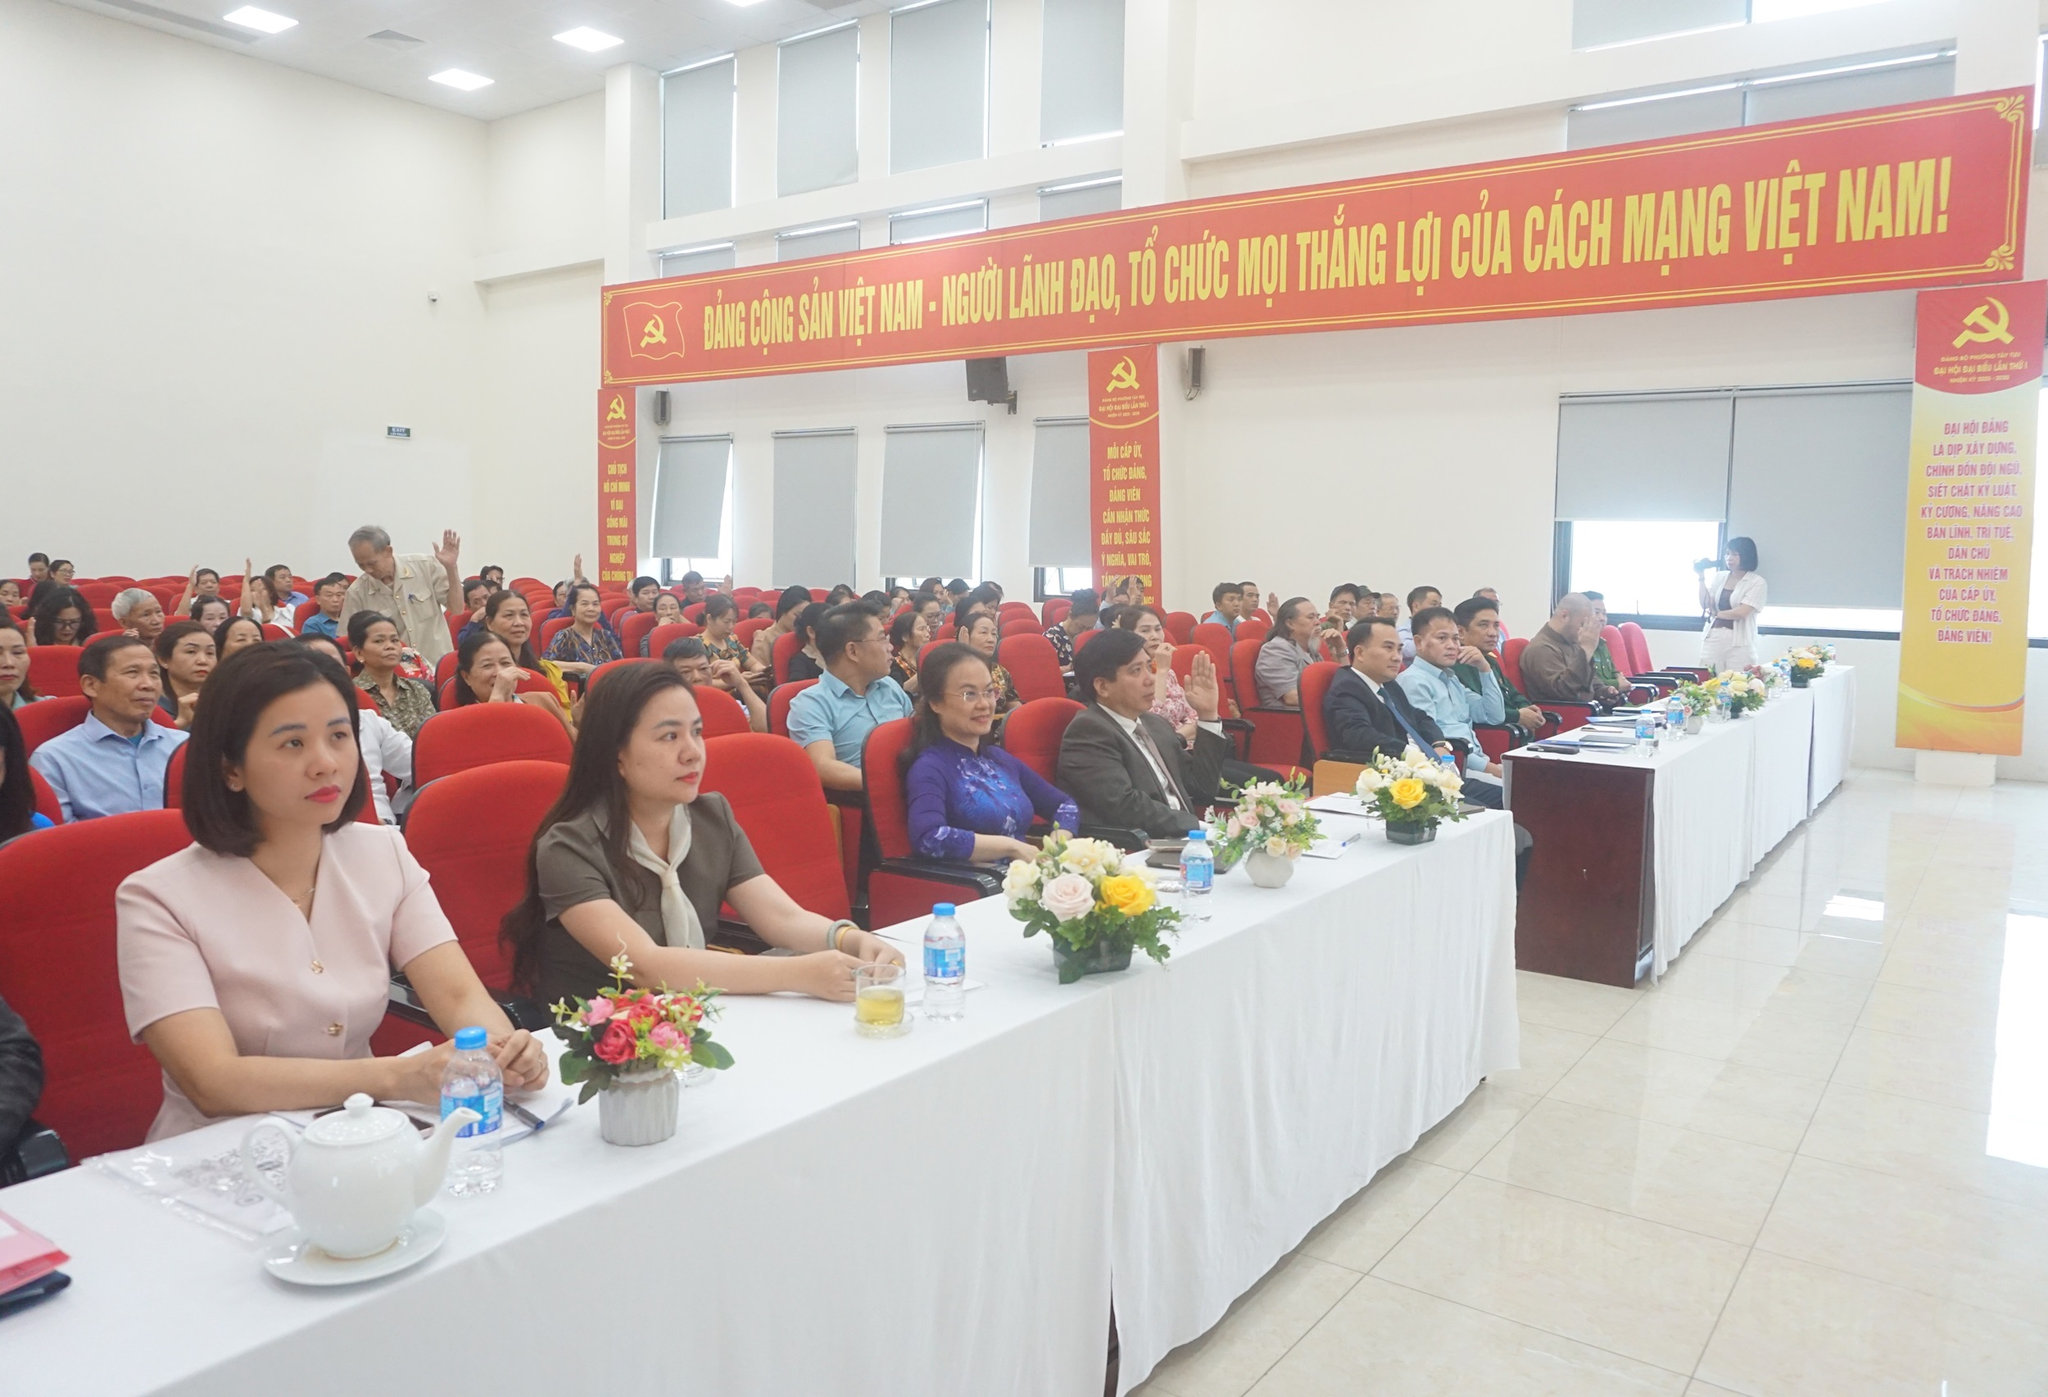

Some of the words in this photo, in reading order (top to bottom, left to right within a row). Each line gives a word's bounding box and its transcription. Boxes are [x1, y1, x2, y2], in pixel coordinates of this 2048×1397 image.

[704, 289, 746, 351] ĐẢNG
[750, 288, 795, 355] CỘNG
[798, 276, 835, 342] SẢN
[838, 276, 876, 347] VIỆT
[880, 279, 924, 333] NAM
[942, 257, 1004, 326] NGƯỜI
[1009, 253, 1065, 319] LÃNH
[1070, 253, 1121, 324] ĐẠO,
[1128, 225, 1159, 307] TỔ
[1164, 229, 1230, 304] CHỨC
[1237, 233, 1289, 309] MỌI
[1296, 203, 1388, 292] THẮNG
[1396, 211, 1442, 297] LỢI
[1451, 188, 1513, 279] CỦA
[1523, 187, 1613, 273] CÁCH
[1623, 184, 1732, 277] MẠNG
[1744, 158, 1827, 266] VIỆT
[1836, 156, 1952, 244] NAM!
